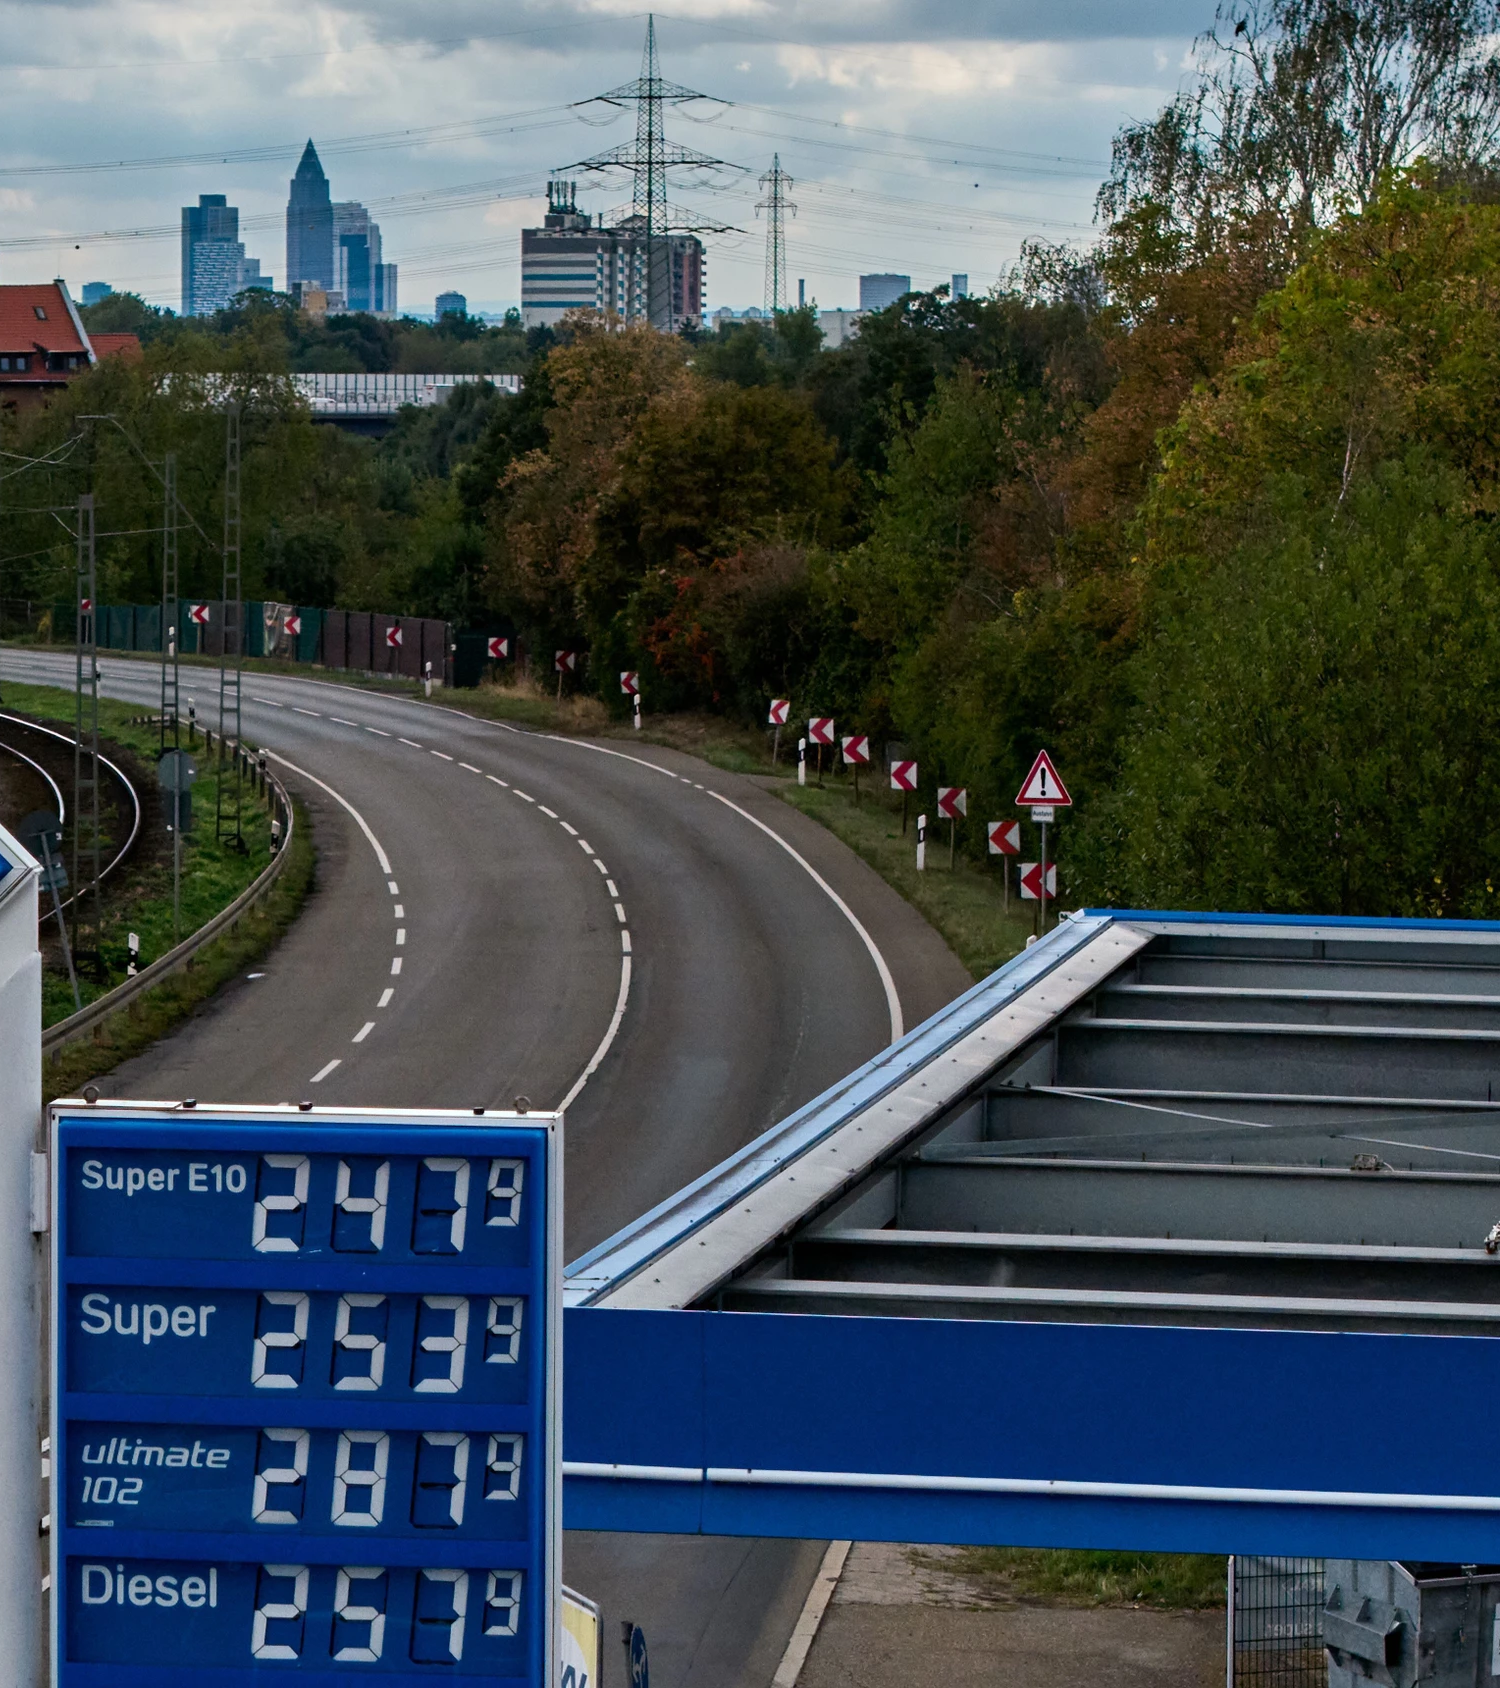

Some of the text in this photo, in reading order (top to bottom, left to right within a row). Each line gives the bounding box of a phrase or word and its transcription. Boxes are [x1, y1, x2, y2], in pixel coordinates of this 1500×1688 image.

[81, 1160, 247, 1196] Super E10
[80, 1294, 216, 1344] Super
[81, 1438, 230, 1470] ultimate
[81, 1476, 143, 1505] 102
[80, 1564, 218, 1608] Diesel
